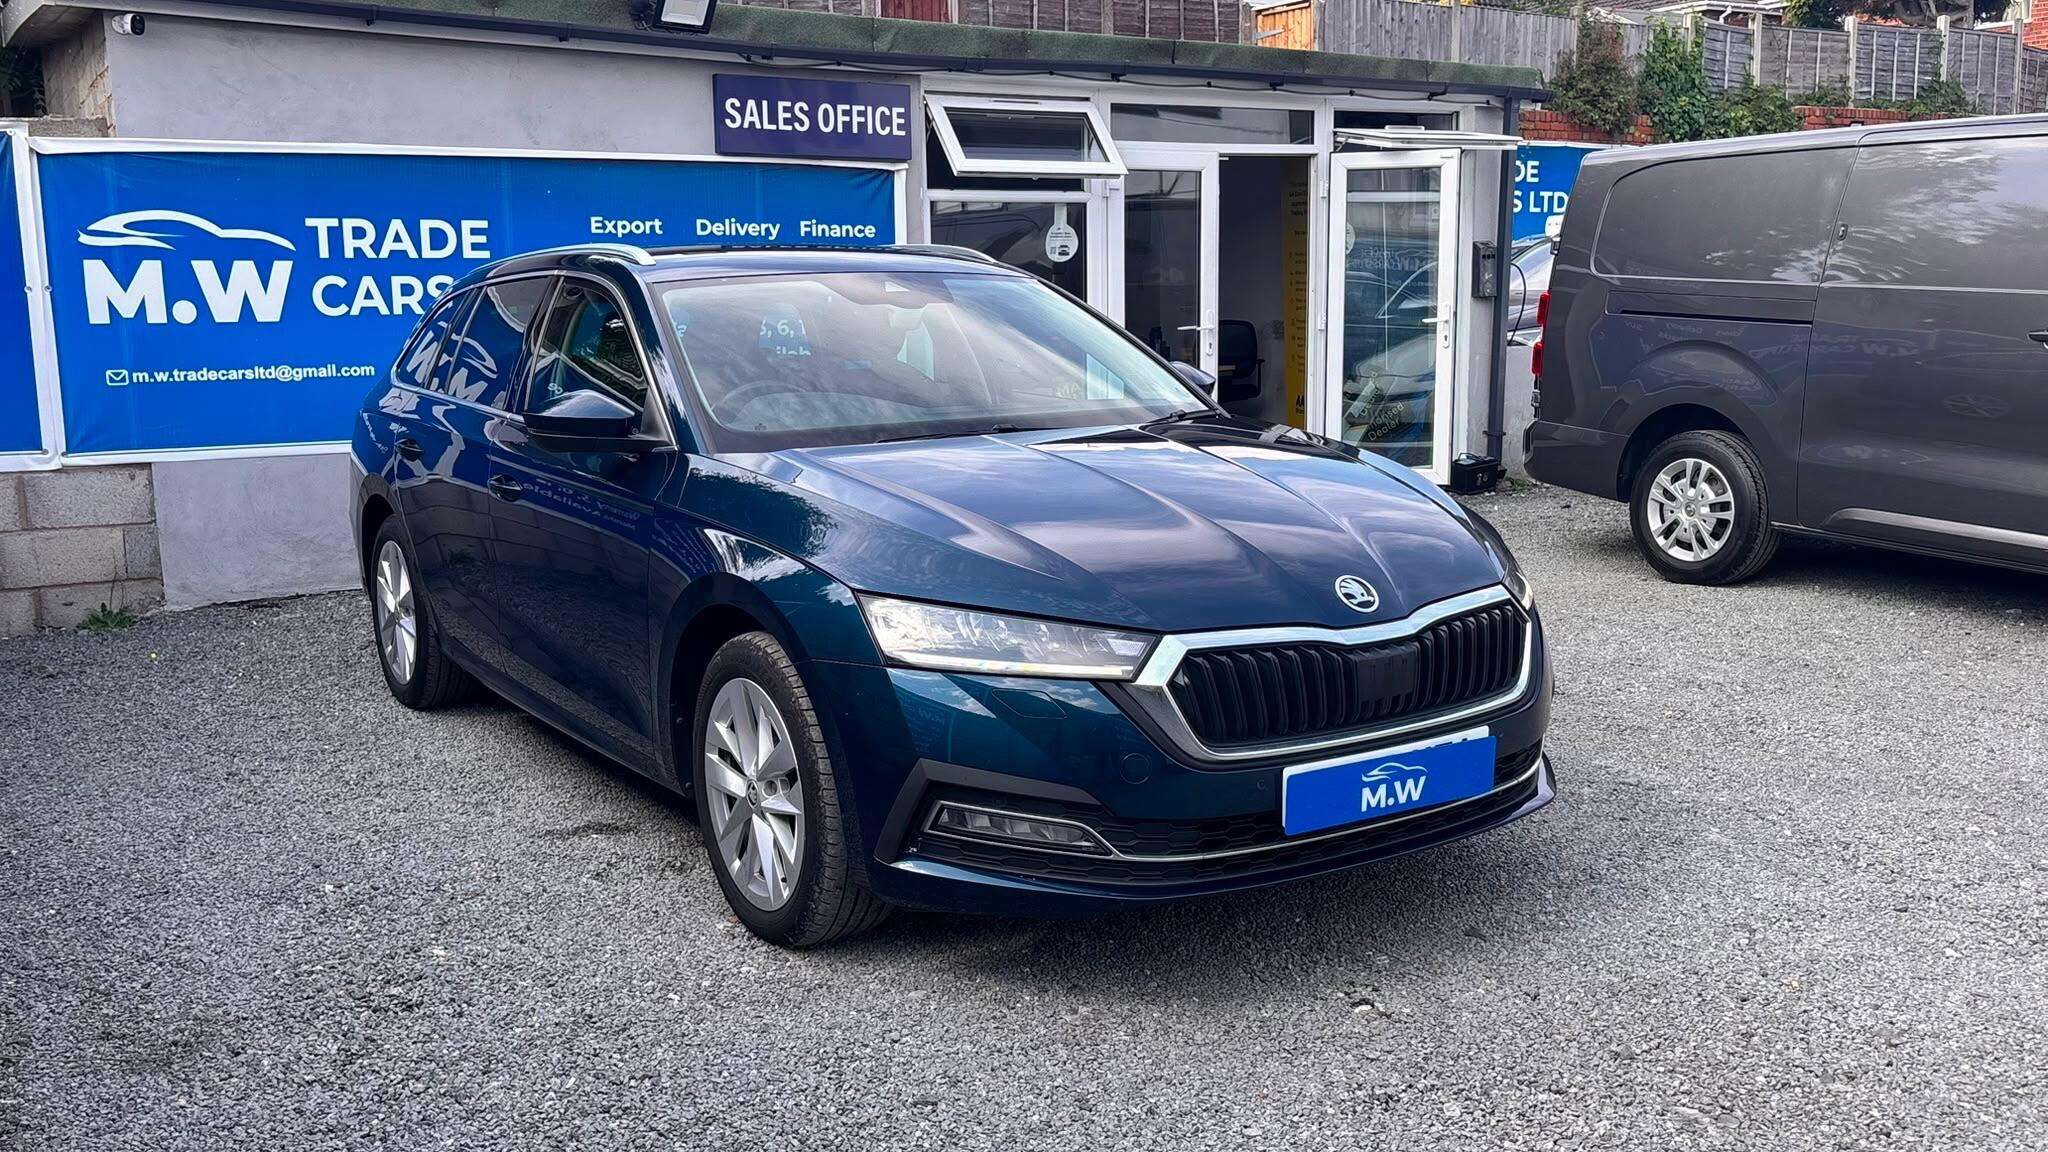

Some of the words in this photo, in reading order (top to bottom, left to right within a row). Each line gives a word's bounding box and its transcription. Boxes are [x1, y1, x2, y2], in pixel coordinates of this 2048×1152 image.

[724, 97, 810, 132] SALES
[817, 103, 907, 136] OFFICE
[1529, 191, 1569, 213] LTD
[304, 217, 491, 259] TRADE
[589, 216, 663, 238] Export
[695, 218, 781, 240] Delivery
[799, 220, 877, 238] Finance
[82, 259, 294, 325] M.W
[131, 363, 376, 384] m.w.tradecarsltd@gmail.com
[1360, 775, 1427, 812] M.W
